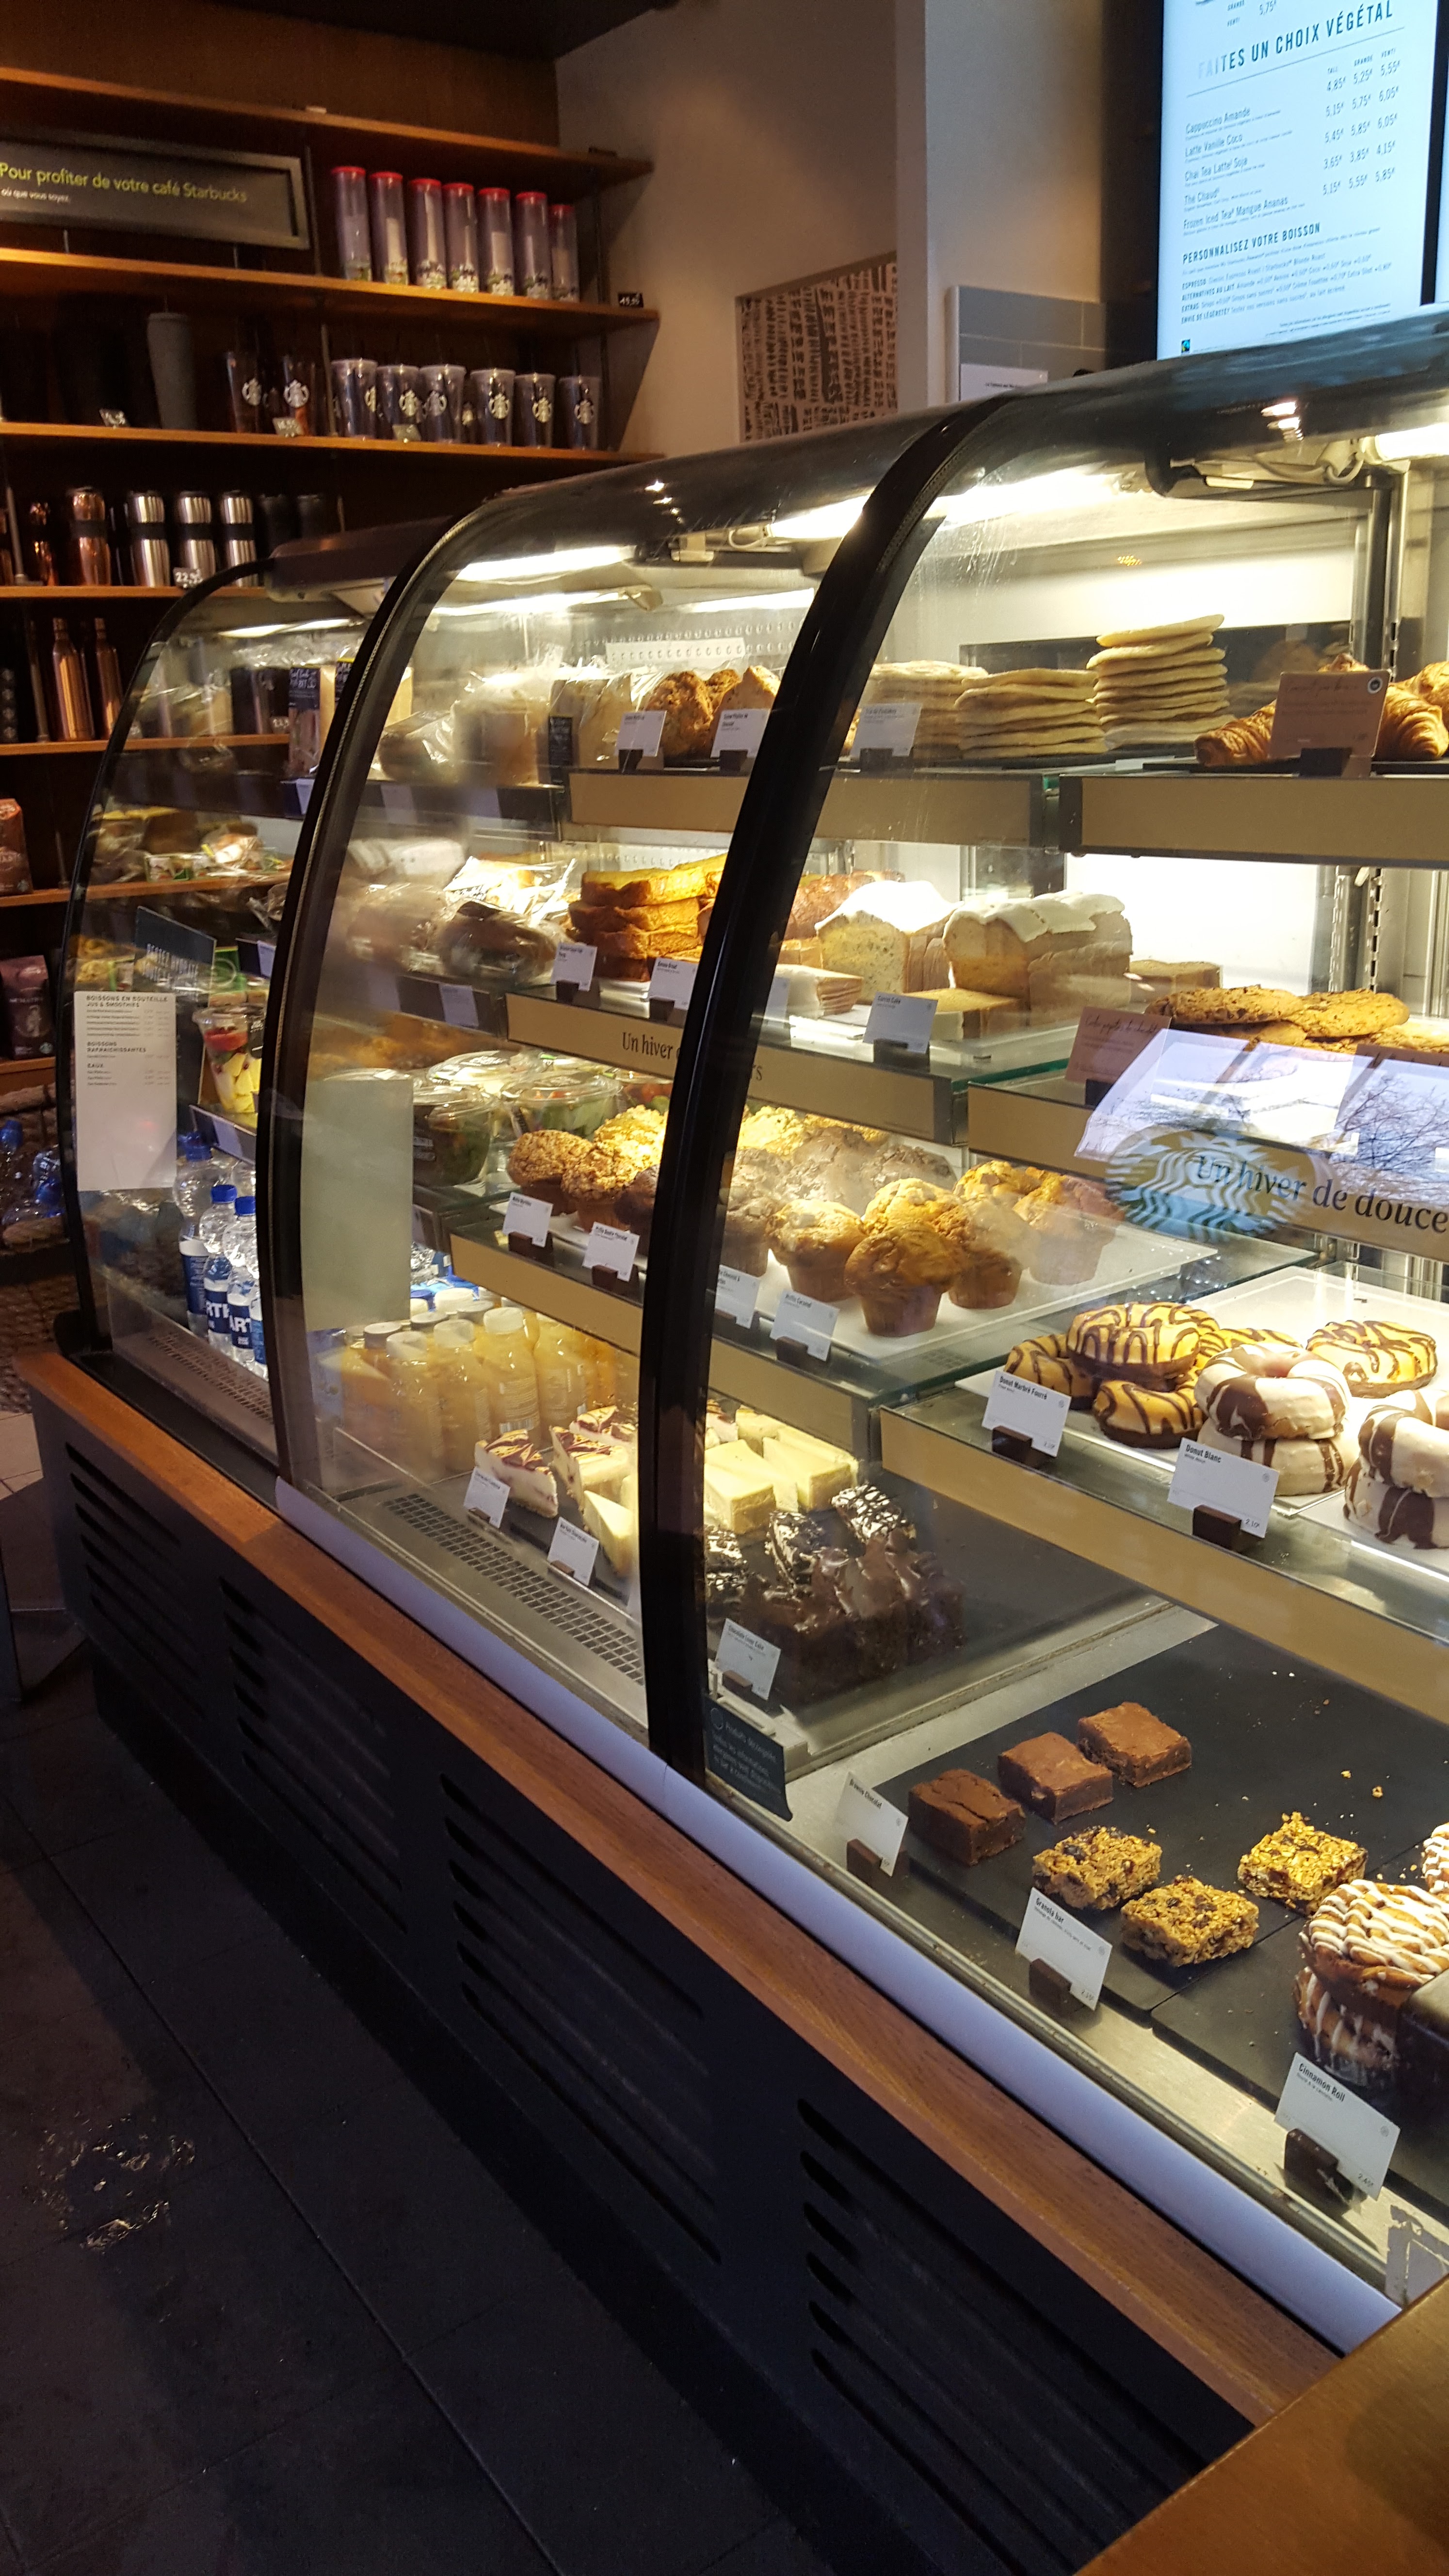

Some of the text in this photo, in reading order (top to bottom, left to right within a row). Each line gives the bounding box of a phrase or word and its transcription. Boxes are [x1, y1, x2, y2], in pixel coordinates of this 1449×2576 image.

[1198, 0, 1392, 79] FAITES UN CHOIX VÉGÉTAL
[1227, 134, 1242, 145] Coco
[0, 161, 247, 204] Pour profiter de votre café Starbucks
[1183, 239, 1248, 265] PERSONNALISEZ
[1252, 232, 1278, 248] VOTRE
[1282, 222, 1320, 242] BOISSON
[622, 1032, 639, 1052] Un
[642, 1034, 673, 1060] hiver
[1198, 1156, 1449, 1233] Un hiver de douce
[999, 1376, 1013, 1387] Donut
[1186, 1444, 1222, 1463] Donut Blanc
[850, 1779, 864, 1795] Brownie
[1036, 1898, 1064, 1924] Granola bar
[1299, 2063, 1346, 2103] Cinnamon Roll
